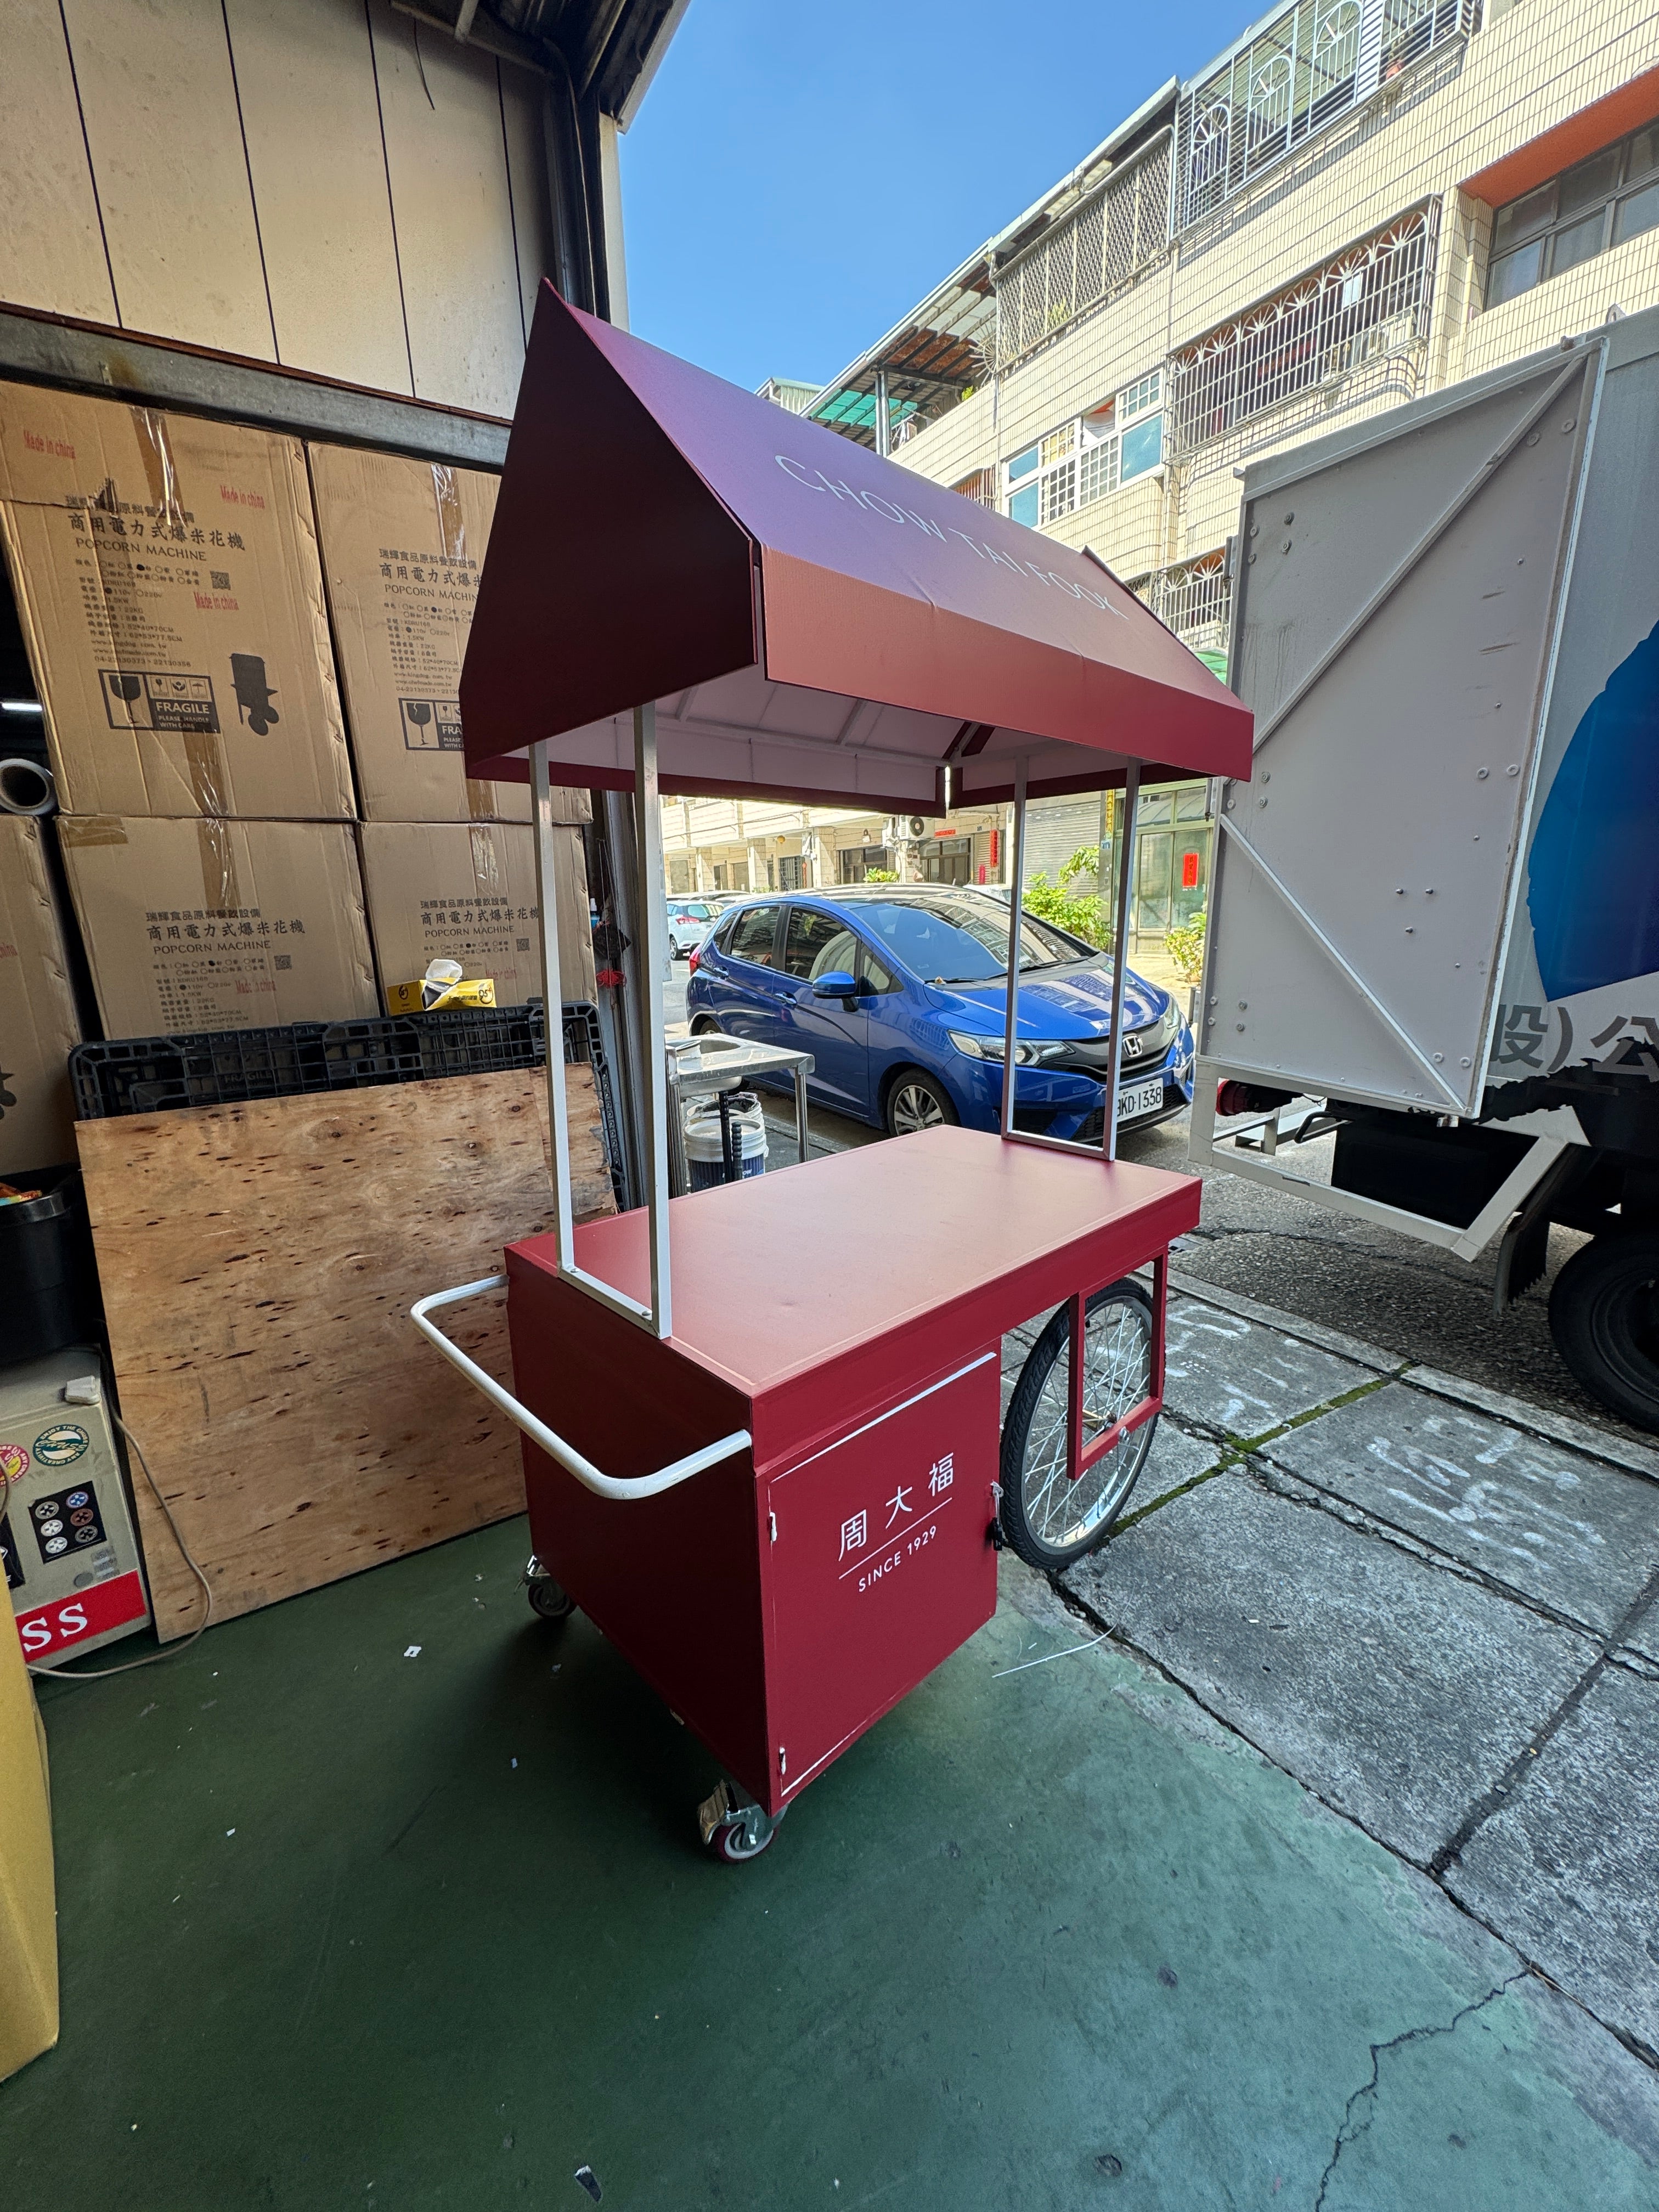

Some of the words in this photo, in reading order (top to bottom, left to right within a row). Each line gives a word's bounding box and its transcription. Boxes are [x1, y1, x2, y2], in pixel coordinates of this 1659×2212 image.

[23, 429, 44, 452] Made
[46, 436, 54, 454] in
[55, 440, 76, 459] china
[220, 484, 239, 505] Made
[240, 489, 247, 505] in
[247, 491, 266, 510] china
[67, 512, 246, 551] 商用電力式爆米花機
[775, 455, 947, 543] CHOW
[948, 527, 1029, 577] TAI
[1025, 560, 1130, 620] FOOK
[76, 537, 140, 553] POPCORN
[146, 545, 207, 561] MACHINE
[194, 592, 213, 610] Made
[213, 593, 220, 610] in
[221, 593, 240, 611] china
[385, 584, 435, 597] POPCORN
[439, 590, 478, 602] MACHIN
[156, 702, 210, 714] FRAGILE
[421, 906, 540, 926] 商用電力式爆米花機
[146, 919, 306, 941] 商用電力式爆米花機
[425, 928, 470, 938] POPCORN
[473, 926, 515, 935] MACHINE
[154, 944, 212, 955] POPCORN
[217, 941, 272, 952] MACHINE
[838, 1452, 954, 1562] 周大福
[859, 1550, 901, 1592] SINCE
[907, 1525, 937, 1556] 1929
